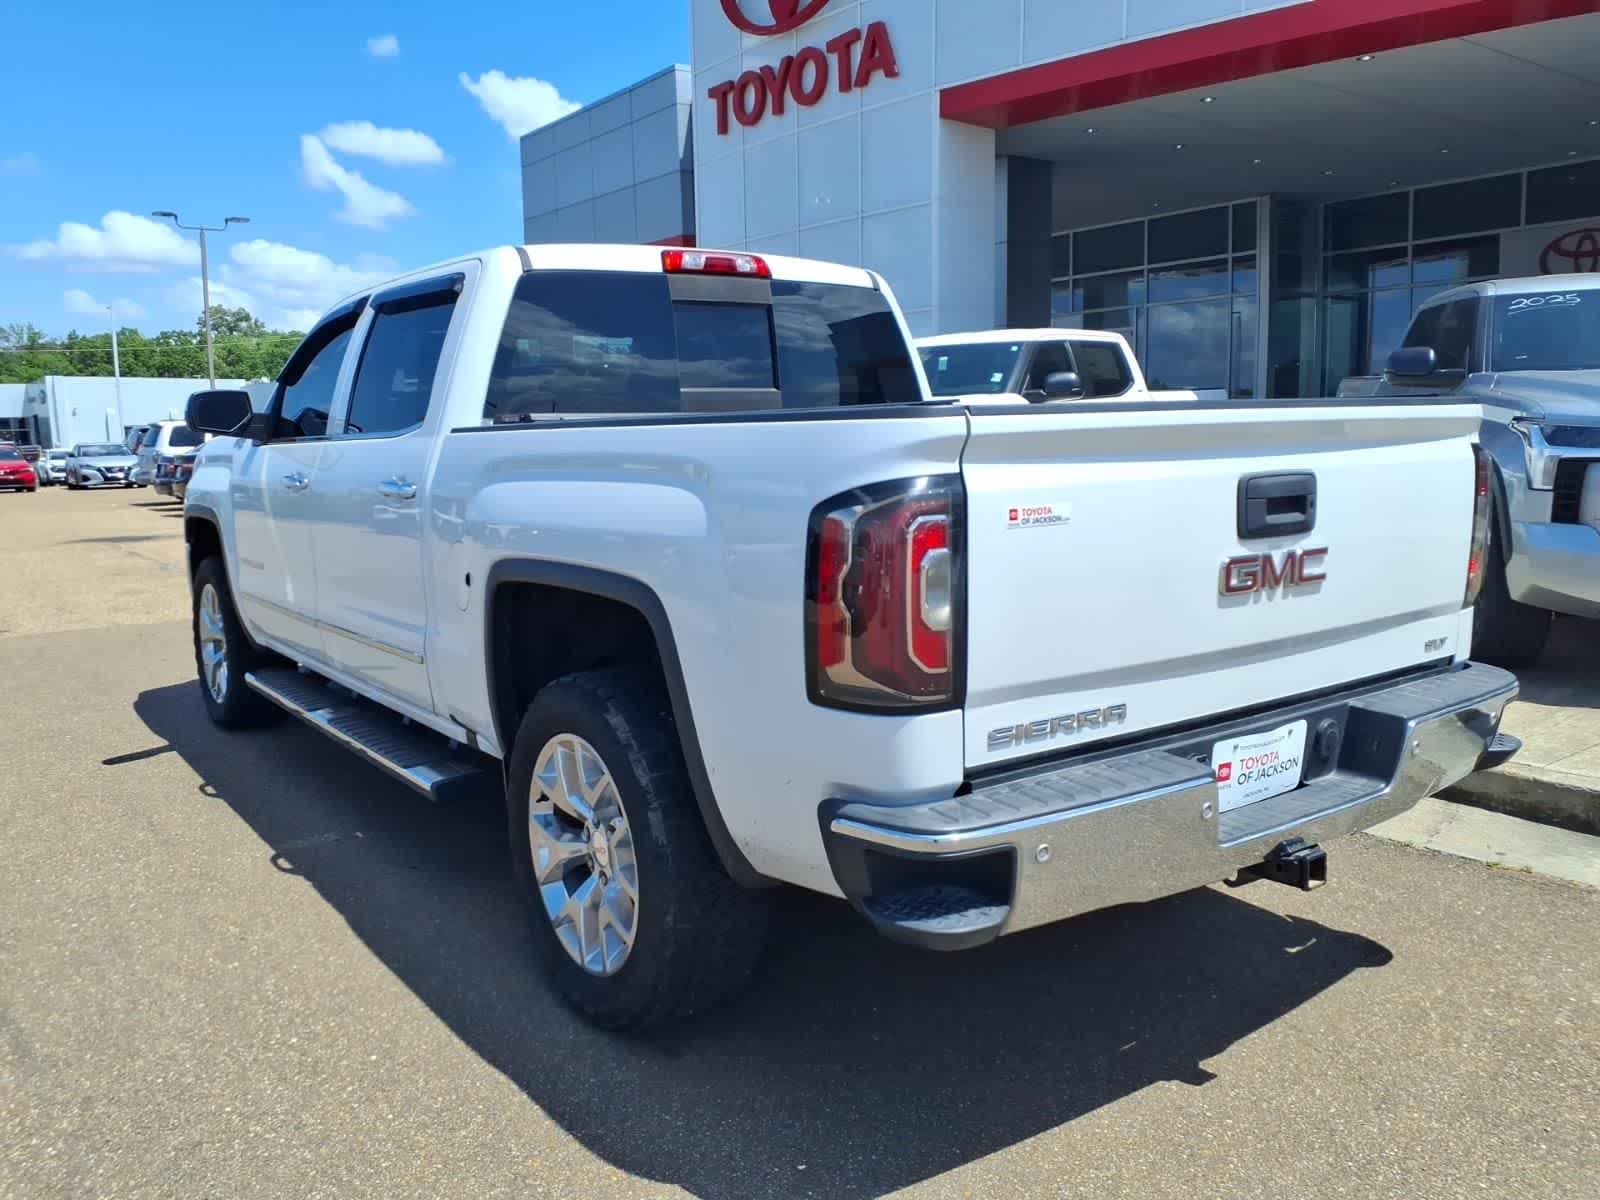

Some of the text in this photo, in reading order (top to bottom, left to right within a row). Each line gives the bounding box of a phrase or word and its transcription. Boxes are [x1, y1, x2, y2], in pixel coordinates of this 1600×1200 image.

[708, 21, 899, 135] TOYOTA
[1508, 294, 1581, 311] 2025
[1022, 506, 1052, 517] TOYOTA
[1218, 547, 1328, 597] GMC
[987, 703, 1126, 749] SIERRA
[1237, 756, 1300, 786] OF JACKSON
[1240, 751, 1280, 771] TOYOTA
